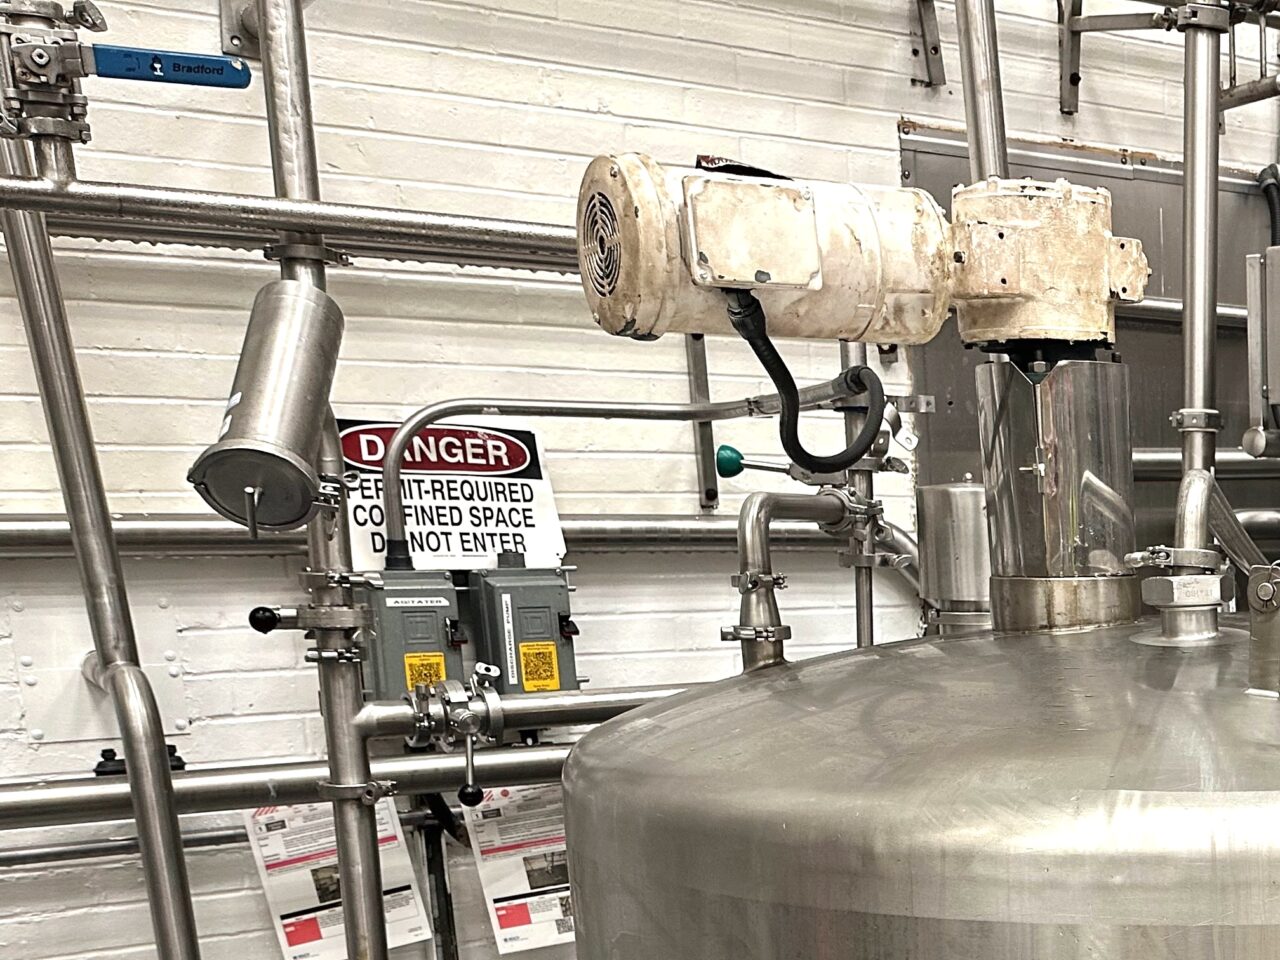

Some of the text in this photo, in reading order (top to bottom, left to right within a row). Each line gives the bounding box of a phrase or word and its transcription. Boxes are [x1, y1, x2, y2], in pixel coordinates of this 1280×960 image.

[172, 63, 224, 76] Bradford
[353, 504, 536, 528] COFINED SPACE
[371, 531, 527, 553] D NOT ENTER
[507, 629, 515, 679] DISCHARGE
